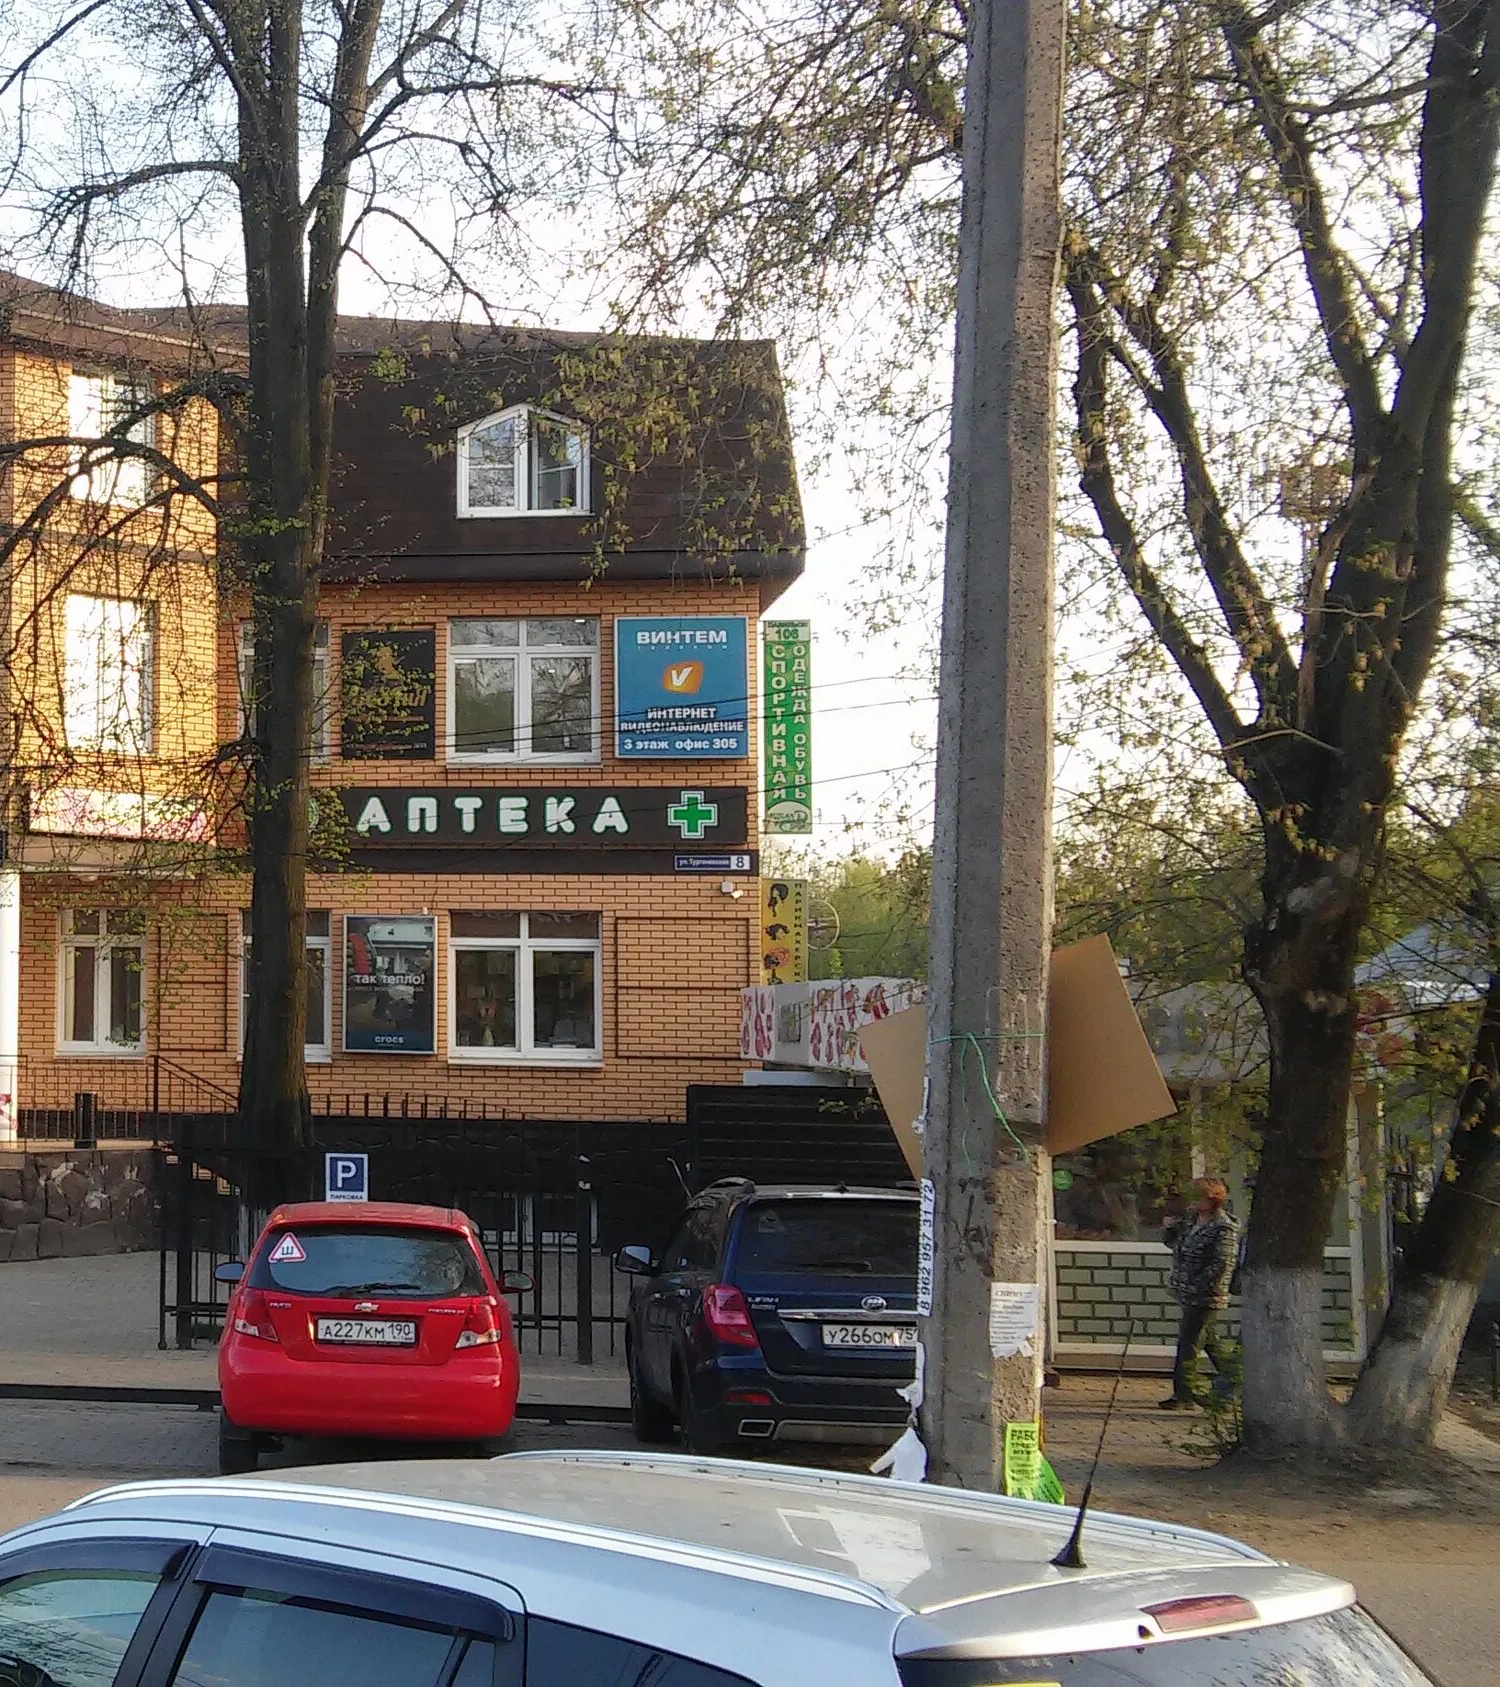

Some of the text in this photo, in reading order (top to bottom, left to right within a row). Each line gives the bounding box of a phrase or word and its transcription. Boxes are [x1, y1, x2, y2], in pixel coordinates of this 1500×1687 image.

[637, 630, 727, 644] ВИНТЕМ
[647, 708, 716, 719] ИНТЕРНЕТ
[620, 722, 744, 733] ВИДЕОНАБЛЮДЕНИЕ
[772, 645, 787, 799] СПОРТИВНАЯ
[792, 645, 807, 799] ОДЕЖДА ОБУВЬ
[624, 738, 737, 750] 3 этаж офис 305
[357, 797, 629, 833] АПТЕКА
[736, 856, 745, 868] 8
[794, 883, 802, 982] ПАРИКМАХЕРСК
[381, 974, 425, 985] тепло!
[375, 1035, 404, 1044] crocs
[337, 1161, 357, 1188] P
[281, 1246, 294, 1256] Ш
[920, 1185, 933, 1310] 8 962 957 31 72
[388, 1323, 411, 1336] 190
[898, 1328, 918, 1341] 75
